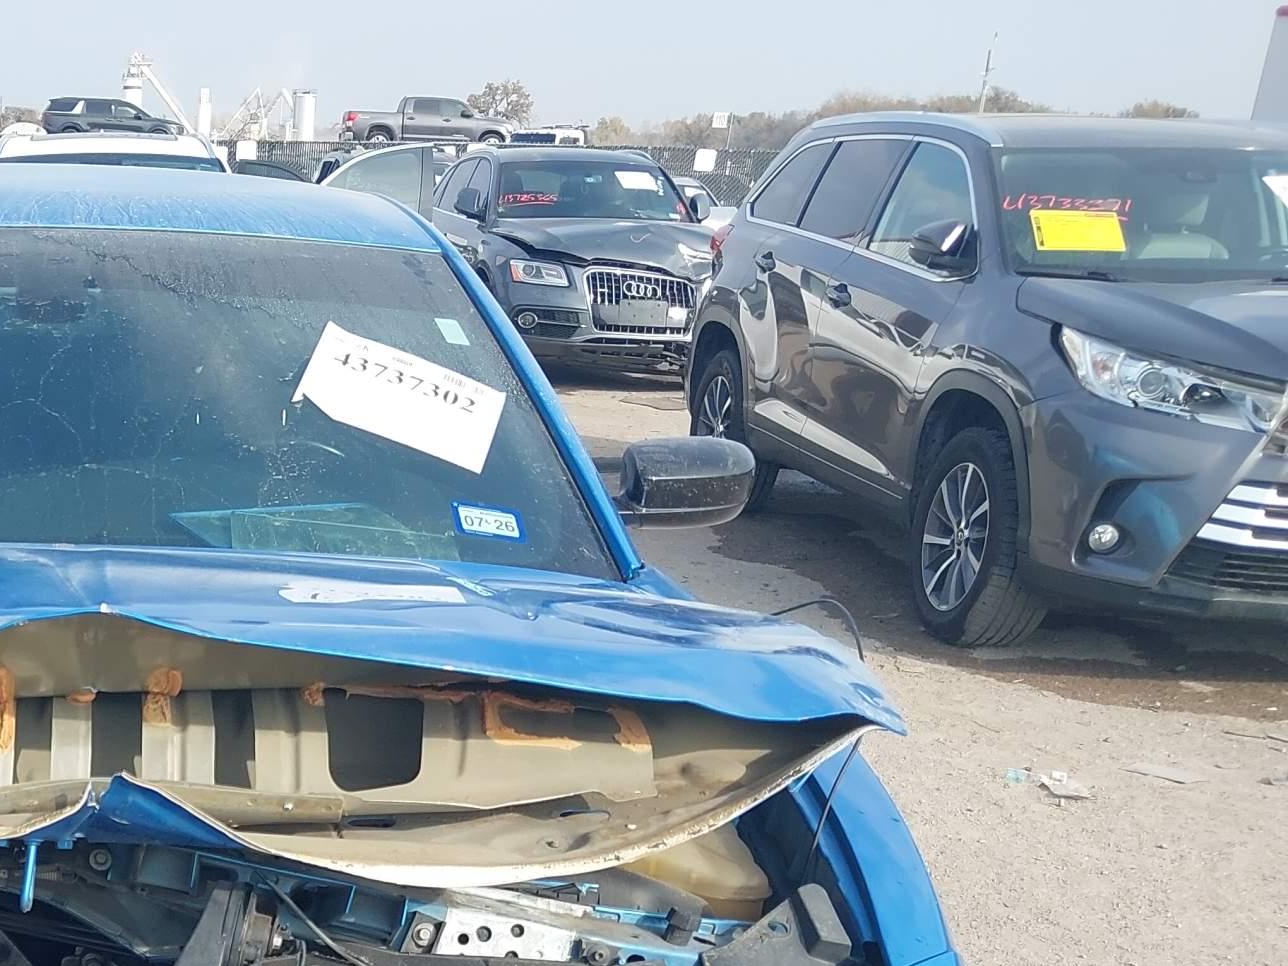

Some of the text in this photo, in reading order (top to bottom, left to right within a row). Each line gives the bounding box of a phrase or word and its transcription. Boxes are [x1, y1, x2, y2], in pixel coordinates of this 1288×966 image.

[333, 353, 478, 414] 43737302
[463, 515, 484, 528] 07
[493, 518, 516, 533] 26
